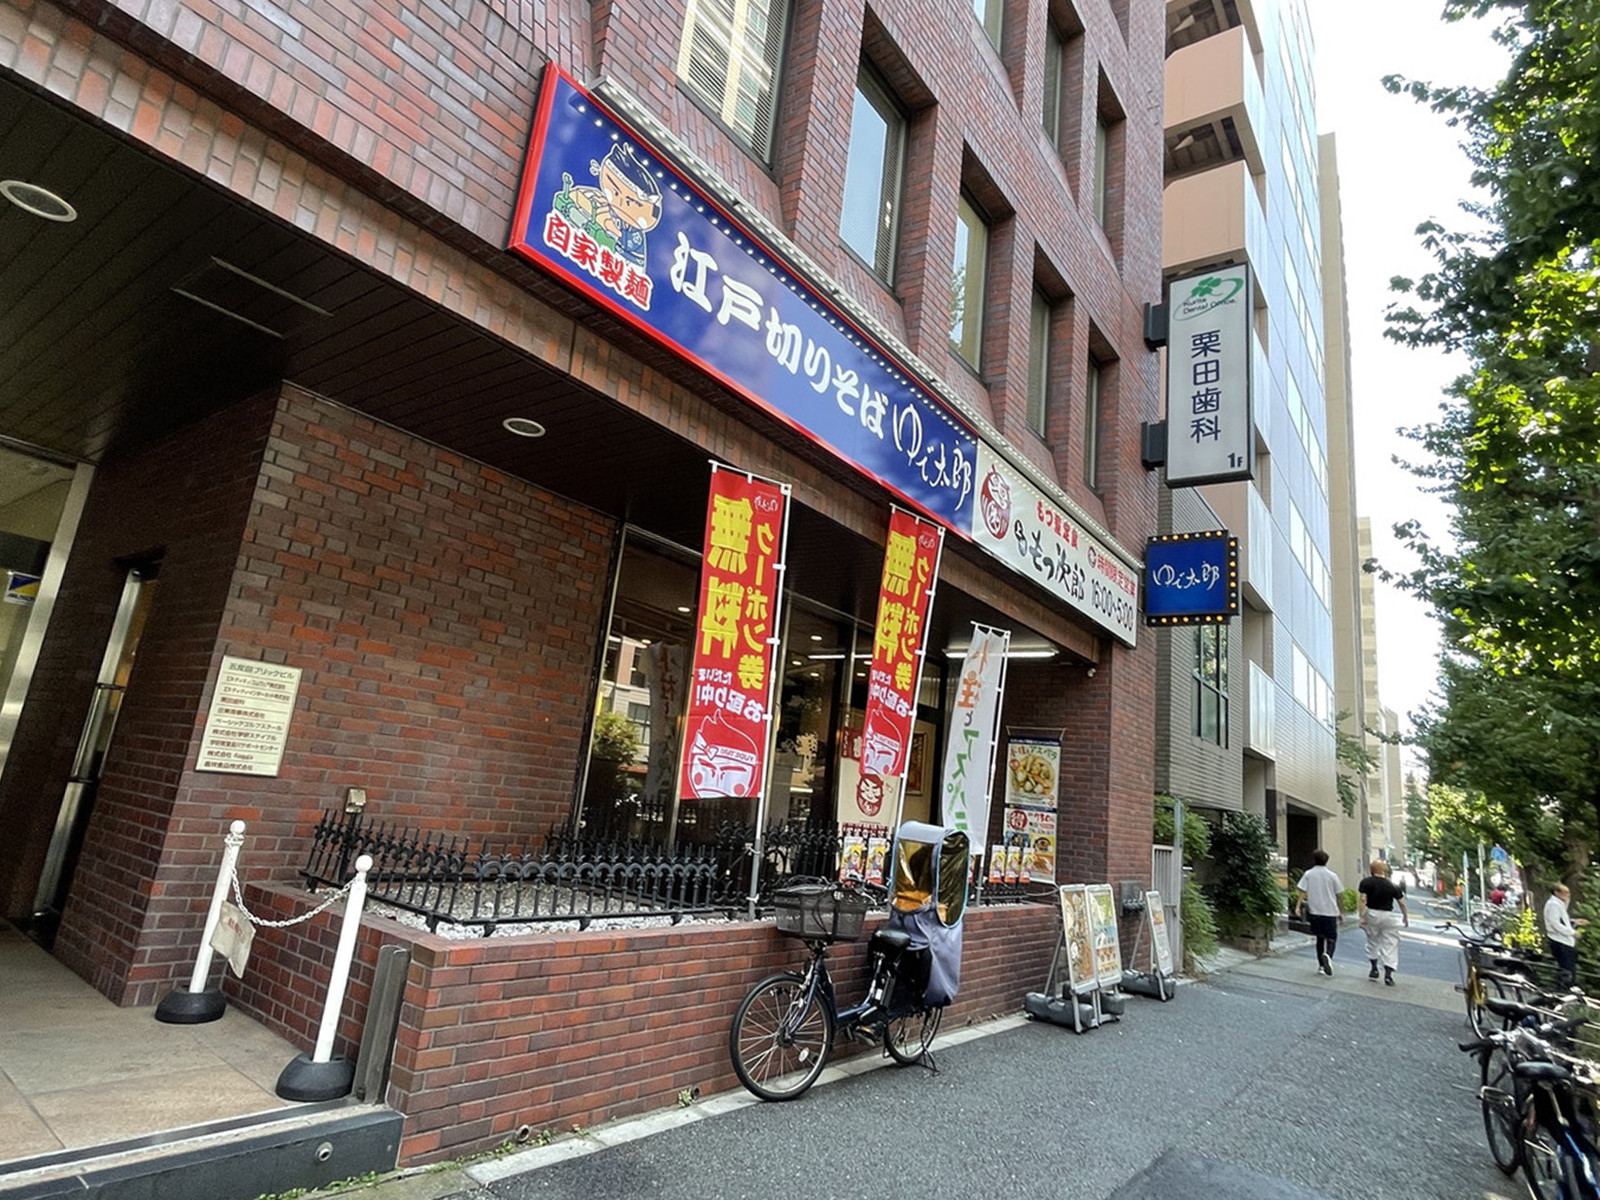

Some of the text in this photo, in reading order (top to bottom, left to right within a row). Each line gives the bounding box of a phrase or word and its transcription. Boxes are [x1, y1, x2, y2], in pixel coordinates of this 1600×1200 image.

[546, 213, 650, 308] 自家製麺
[670, 231, 971, 511] 江戸切りそば ゆで太郎
[1190, 329, 1222, 443] 栗田歯科
[1227, 452, 1243, 468] 1F
[1152, 560, 1220, 591] ゆで太郎
